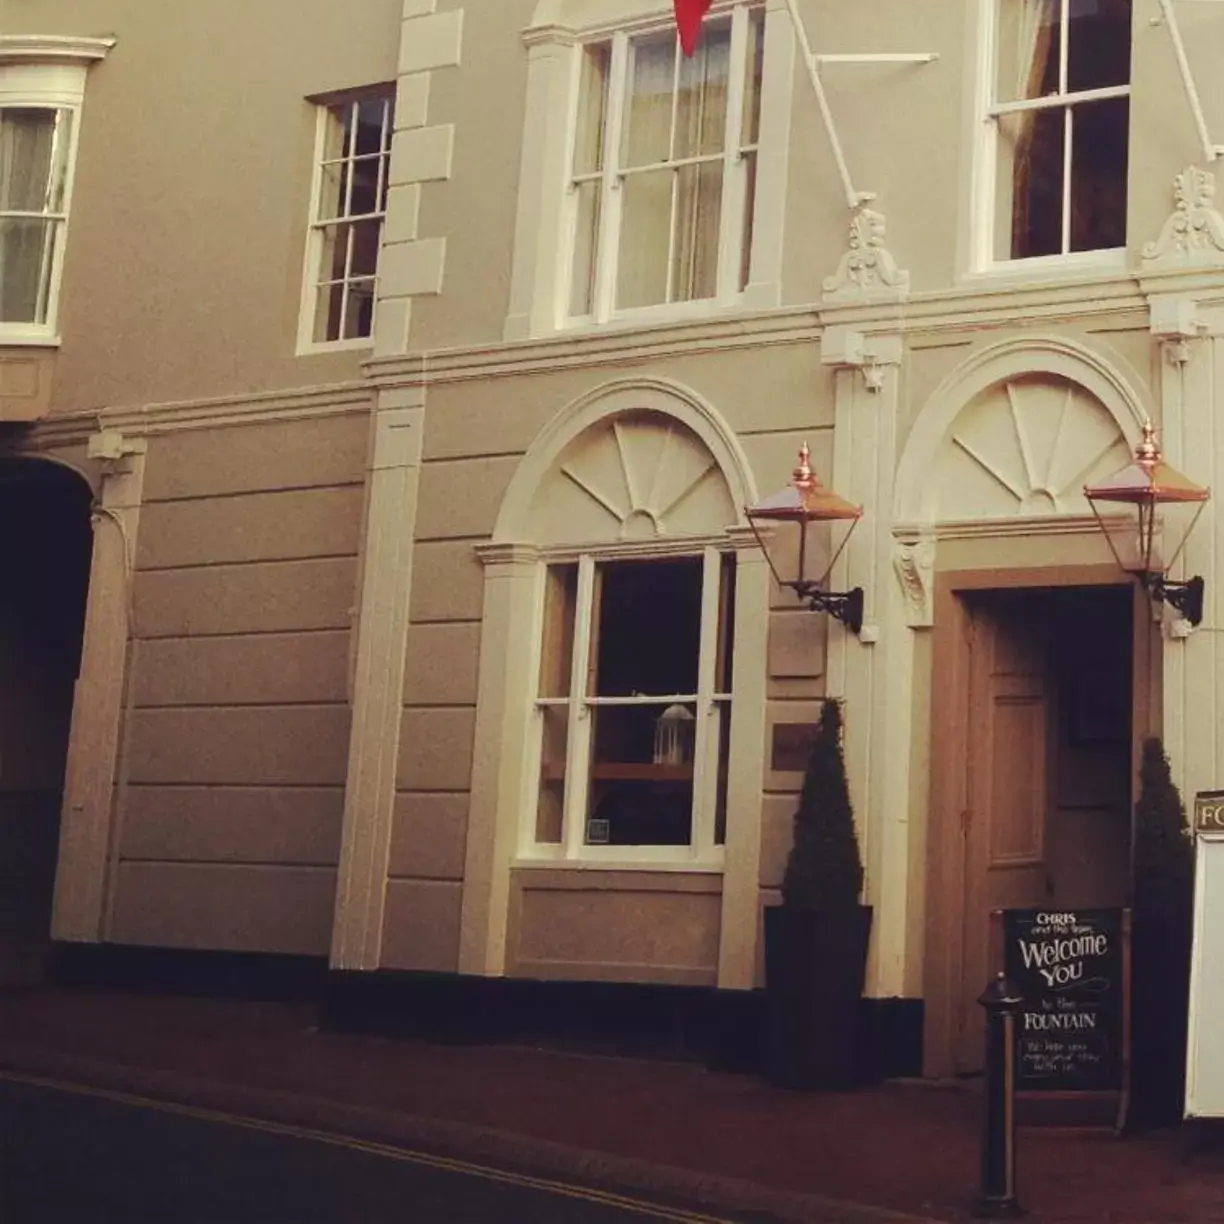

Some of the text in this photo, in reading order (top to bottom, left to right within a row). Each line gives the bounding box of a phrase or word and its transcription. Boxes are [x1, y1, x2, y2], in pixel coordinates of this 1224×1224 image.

[1036, 912, 1077, 926] CHRIS
[1018, 934, 1109, 969] Welcome
[1039, 961, 1083, 987] YOU
[1024, 1012, 1097, 1030] FOUNTAIN
